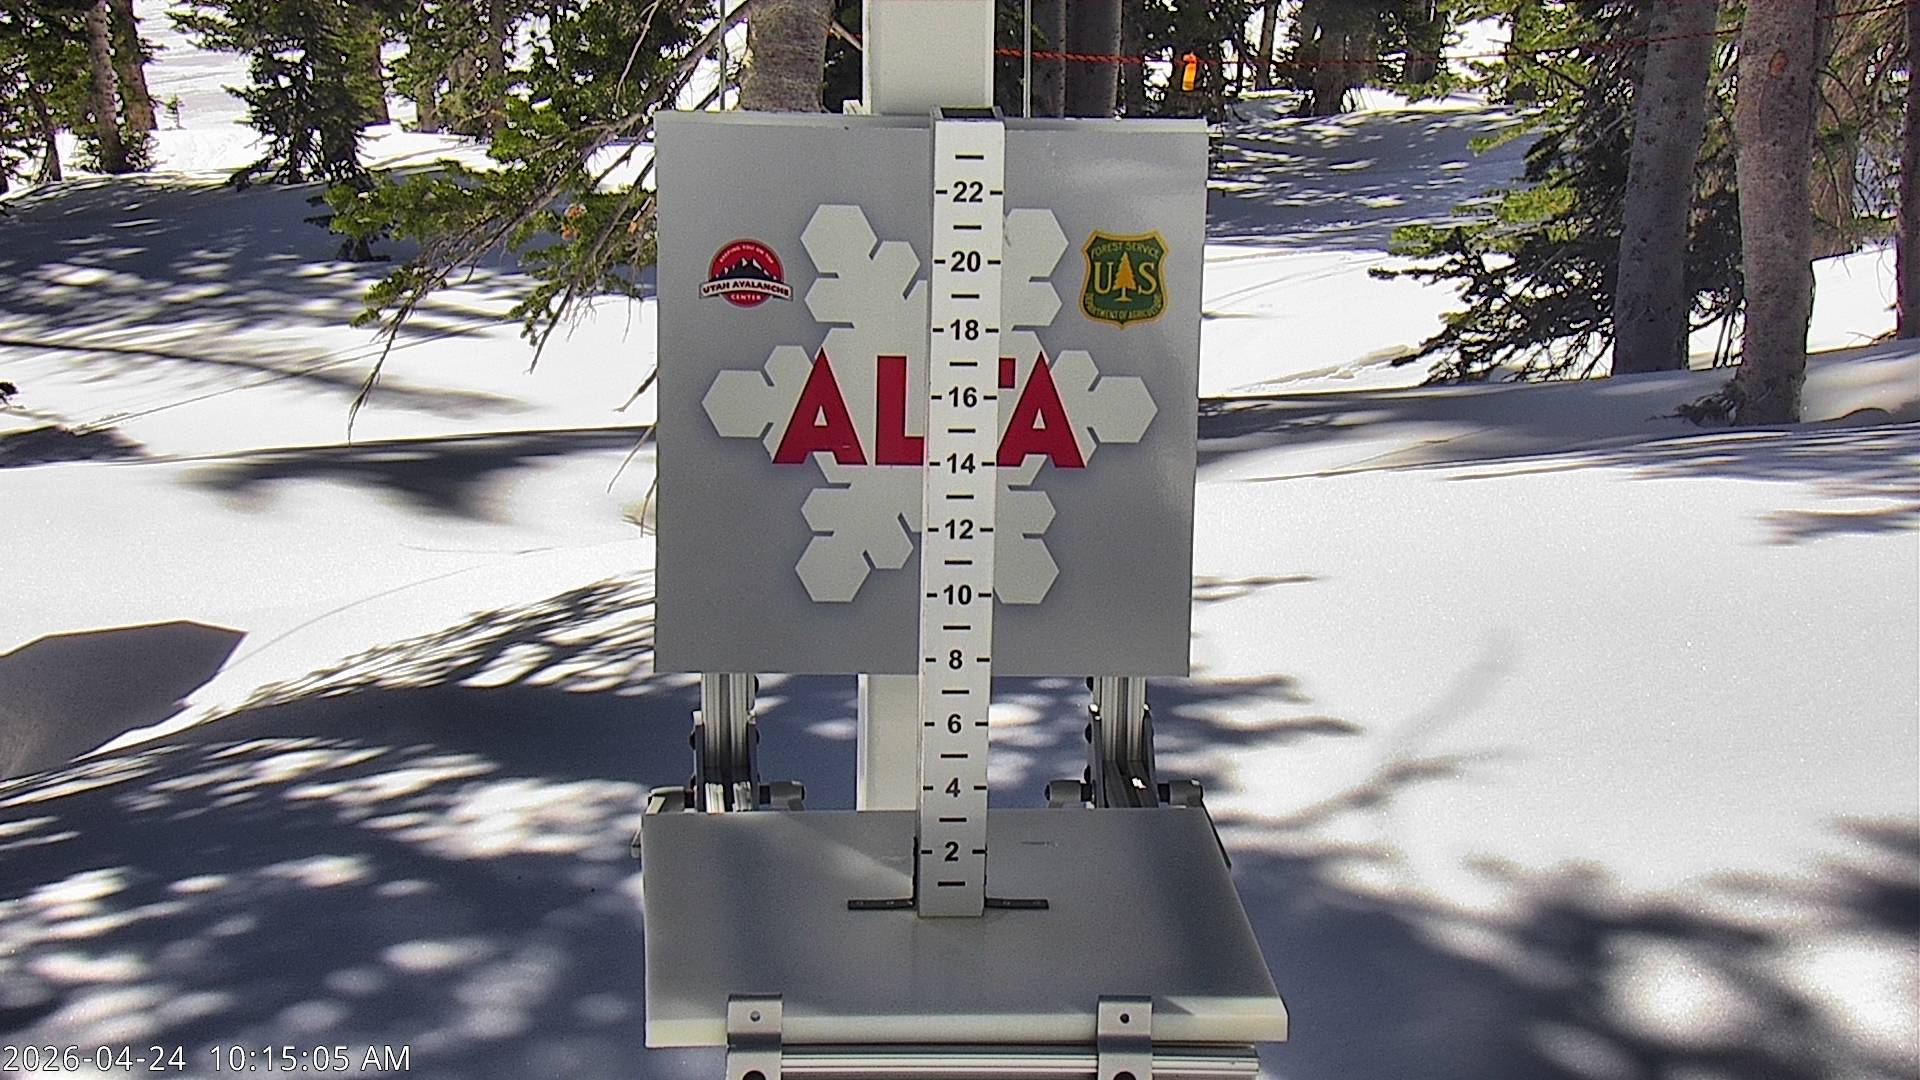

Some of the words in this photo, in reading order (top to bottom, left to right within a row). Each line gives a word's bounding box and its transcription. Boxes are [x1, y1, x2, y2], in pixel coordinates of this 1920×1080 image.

[952, 180, 984, 203] 22
[950, 250, 981, 273] 20
[1091, 242, 1122, 259] FOREST
[702, 282, 731, 294] UTAH
[732, 281, 789, 296] AVALANCHE
[730, 293, 762, 301] CENTER
[950, 318, 980, 341] 18
[772, 347, 1085, 469] ALA
[949, 386, 978, 408] 16
[947, 452, 976, 474] 14
[945, 518, 974, 541] 12
[943, 584, 972, 606] 10
[948, 649, 963, 671] 8
[947, 713, 962, 735] 6
[944, 777, 961, 799] 4
[943, 840, 960, 863] 2
